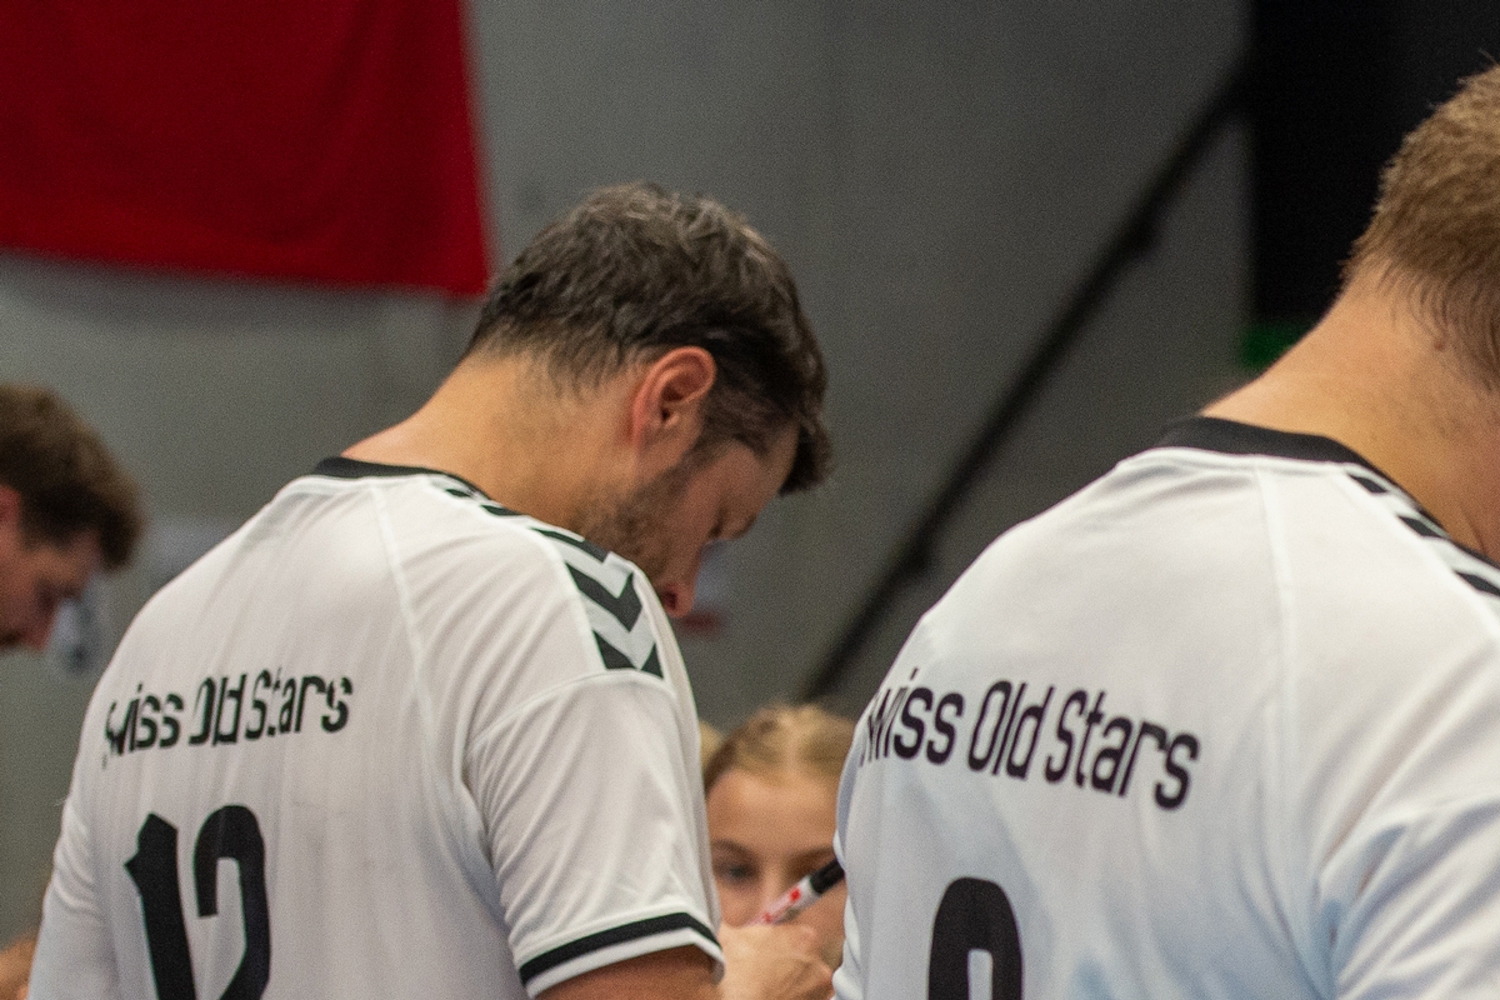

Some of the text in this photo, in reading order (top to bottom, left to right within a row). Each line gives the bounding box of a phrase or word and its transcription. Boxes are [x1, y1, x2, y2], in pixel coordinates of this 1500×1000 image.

[101, 682, 184, 769] wiss
[859, 667, 1200, 811] wiss Old Stars
